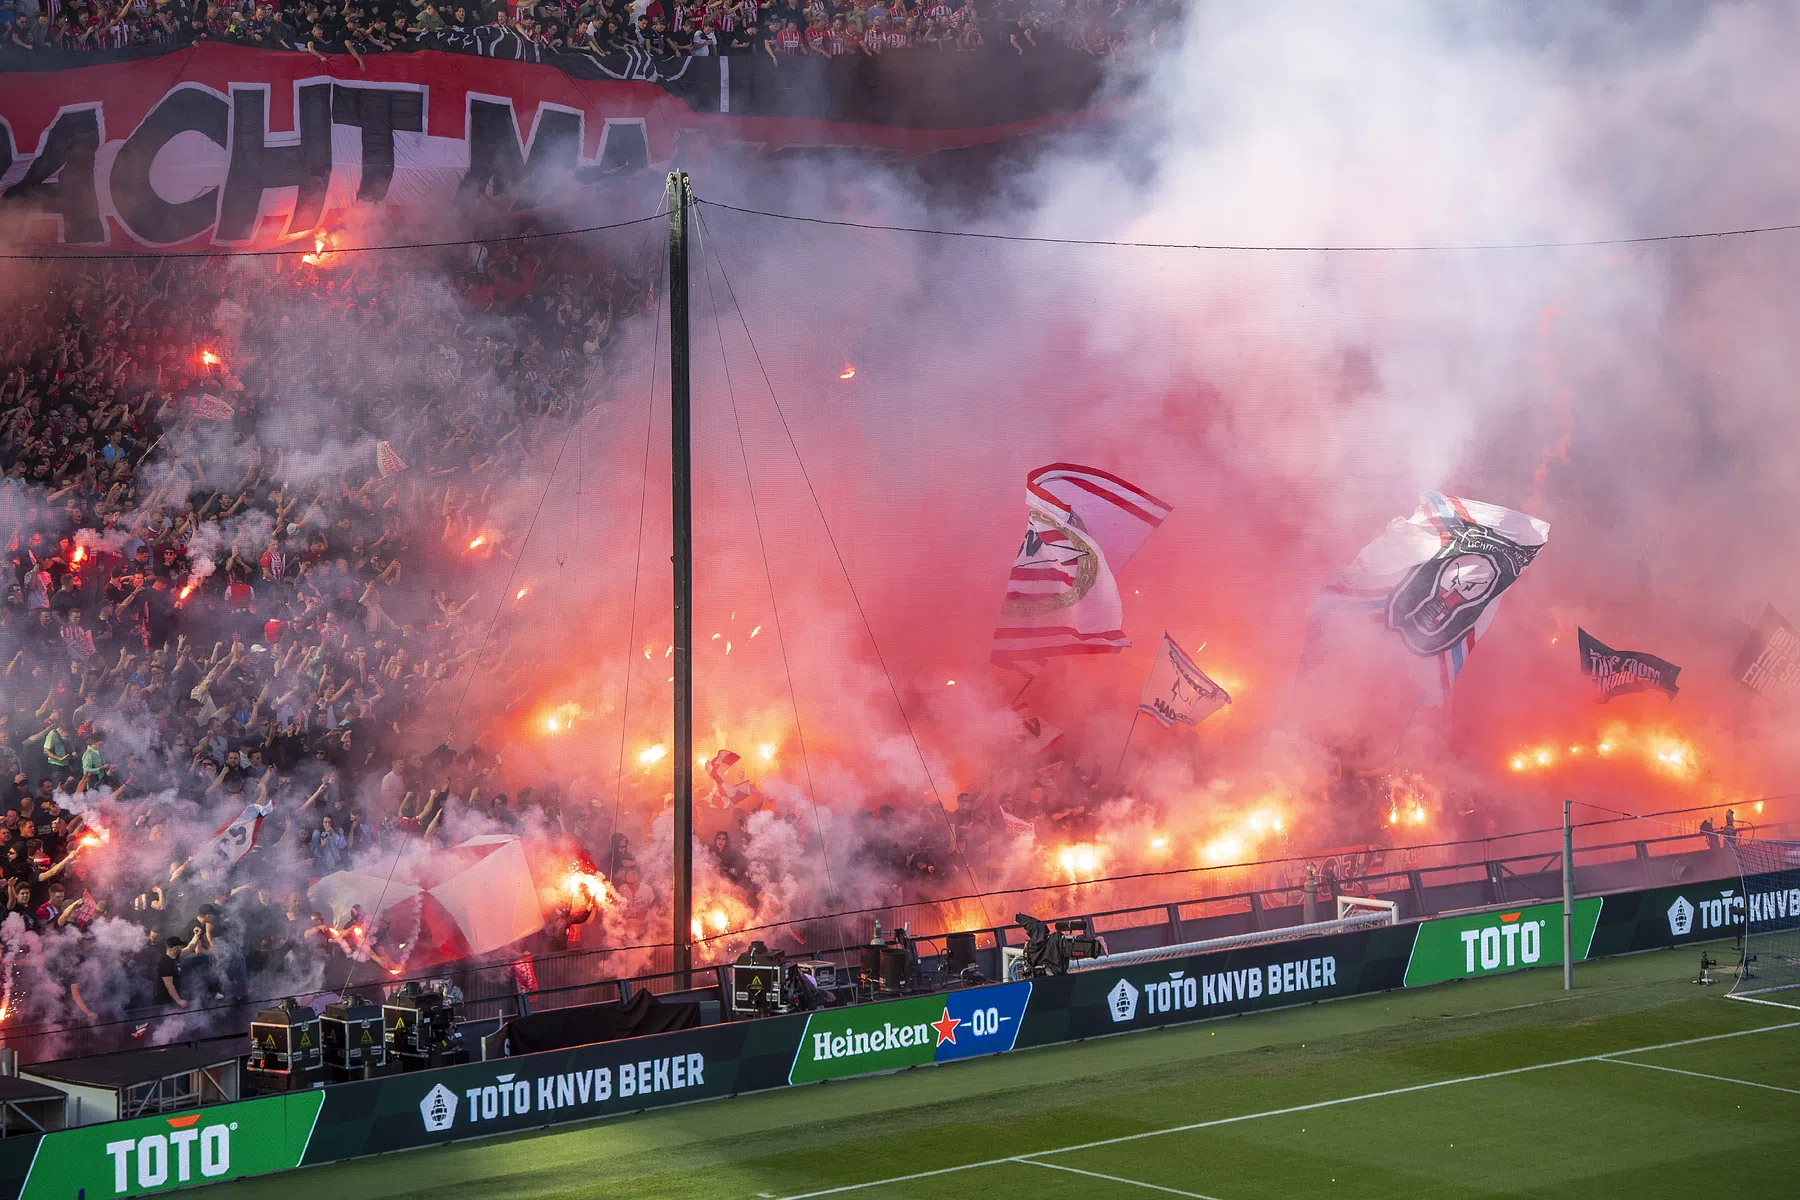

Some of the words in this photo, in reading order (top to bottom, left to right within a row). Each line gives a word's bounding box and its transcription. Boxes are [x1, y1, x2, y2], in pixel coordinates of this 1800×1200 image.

[0, 77, 428, 248] ACHT
[1144, 975, 1197, 1015] TOTO
[1202, 967, 1263, 1006] KNVB
[1268, 955, 1337, 996] BEKER
[813, 1022, 930, 1061] Heineken
[466, 1078, 531, 1123] TOTO
[537, 1067, 612, 1111] KNVB
[619, 1052, 705, 1098] BEKER
